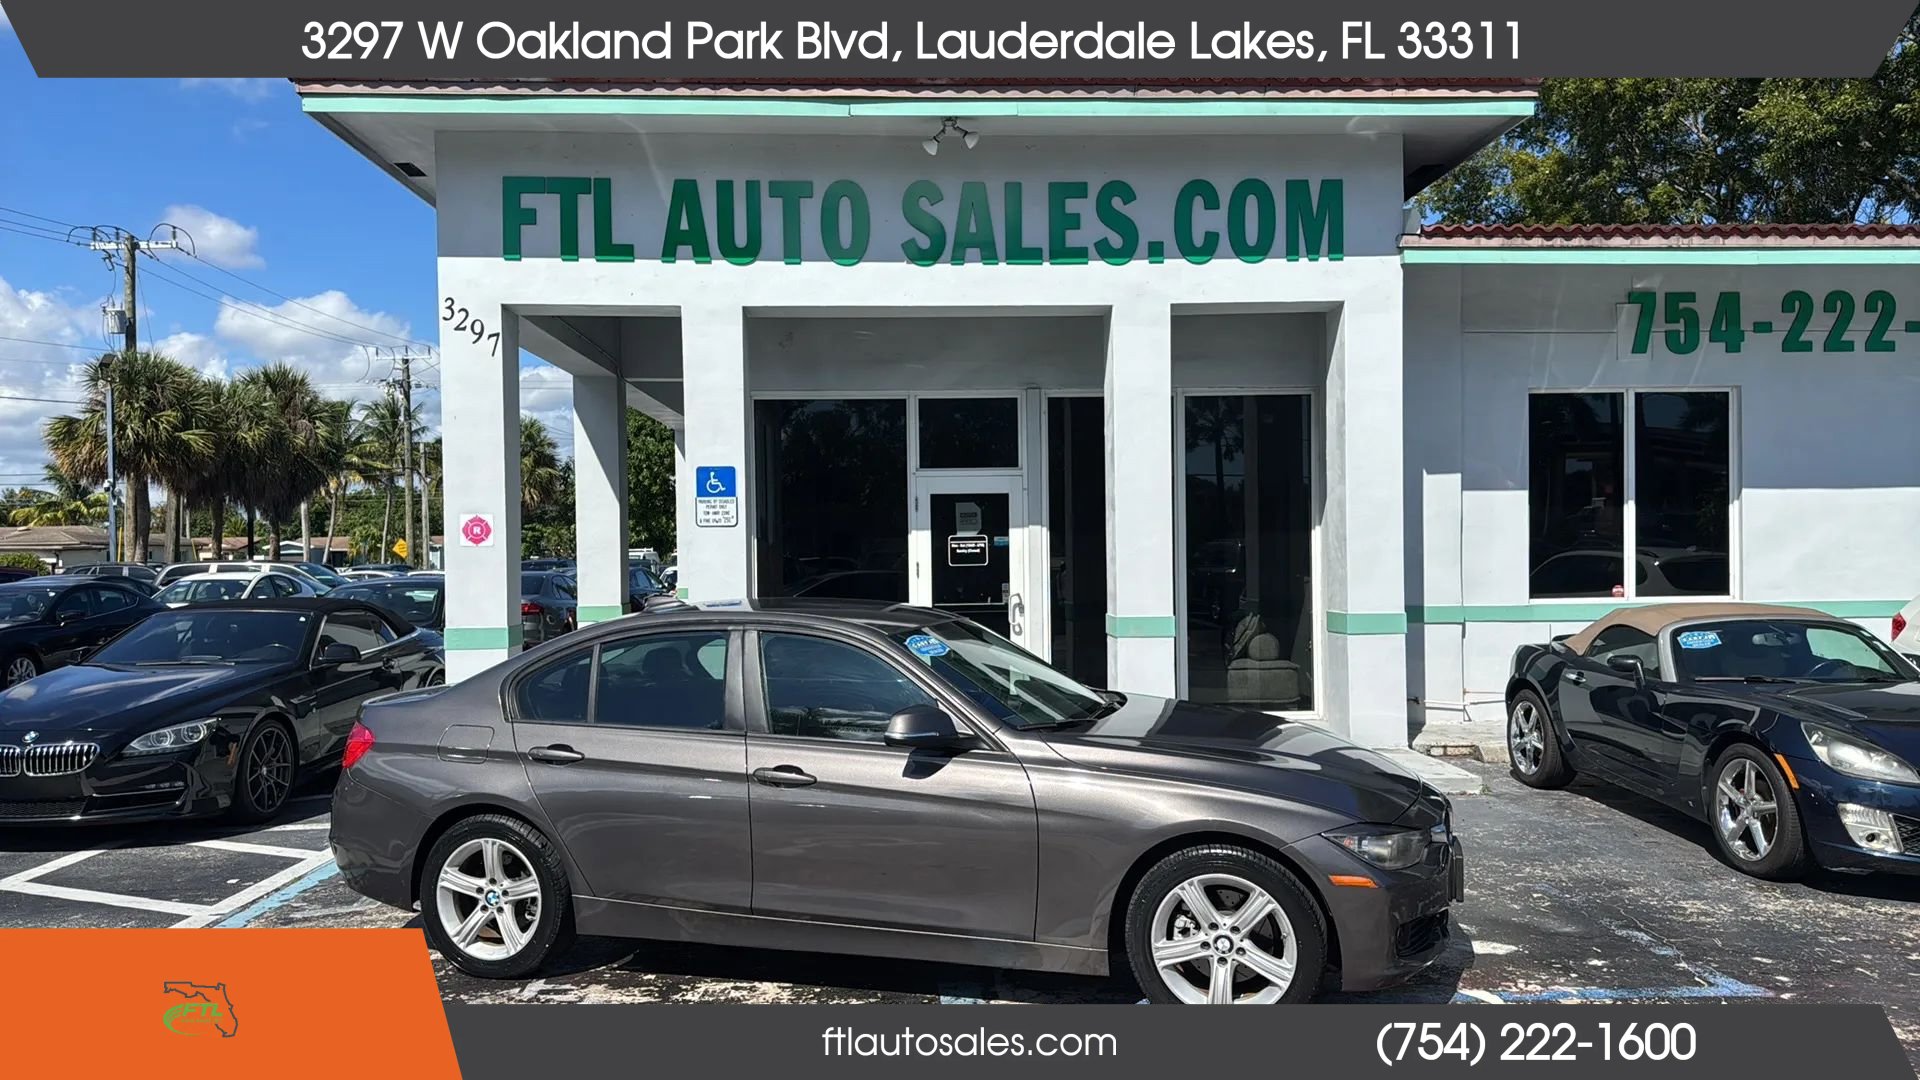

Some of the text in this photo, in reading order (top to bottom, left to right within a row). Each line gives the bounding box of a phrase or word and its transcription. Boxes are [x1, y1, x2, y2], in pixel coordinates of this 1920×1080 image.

[502, 176, 1345, 266] FTL AUTO SALES.COM
[442, 297, 500, 357] 3297
